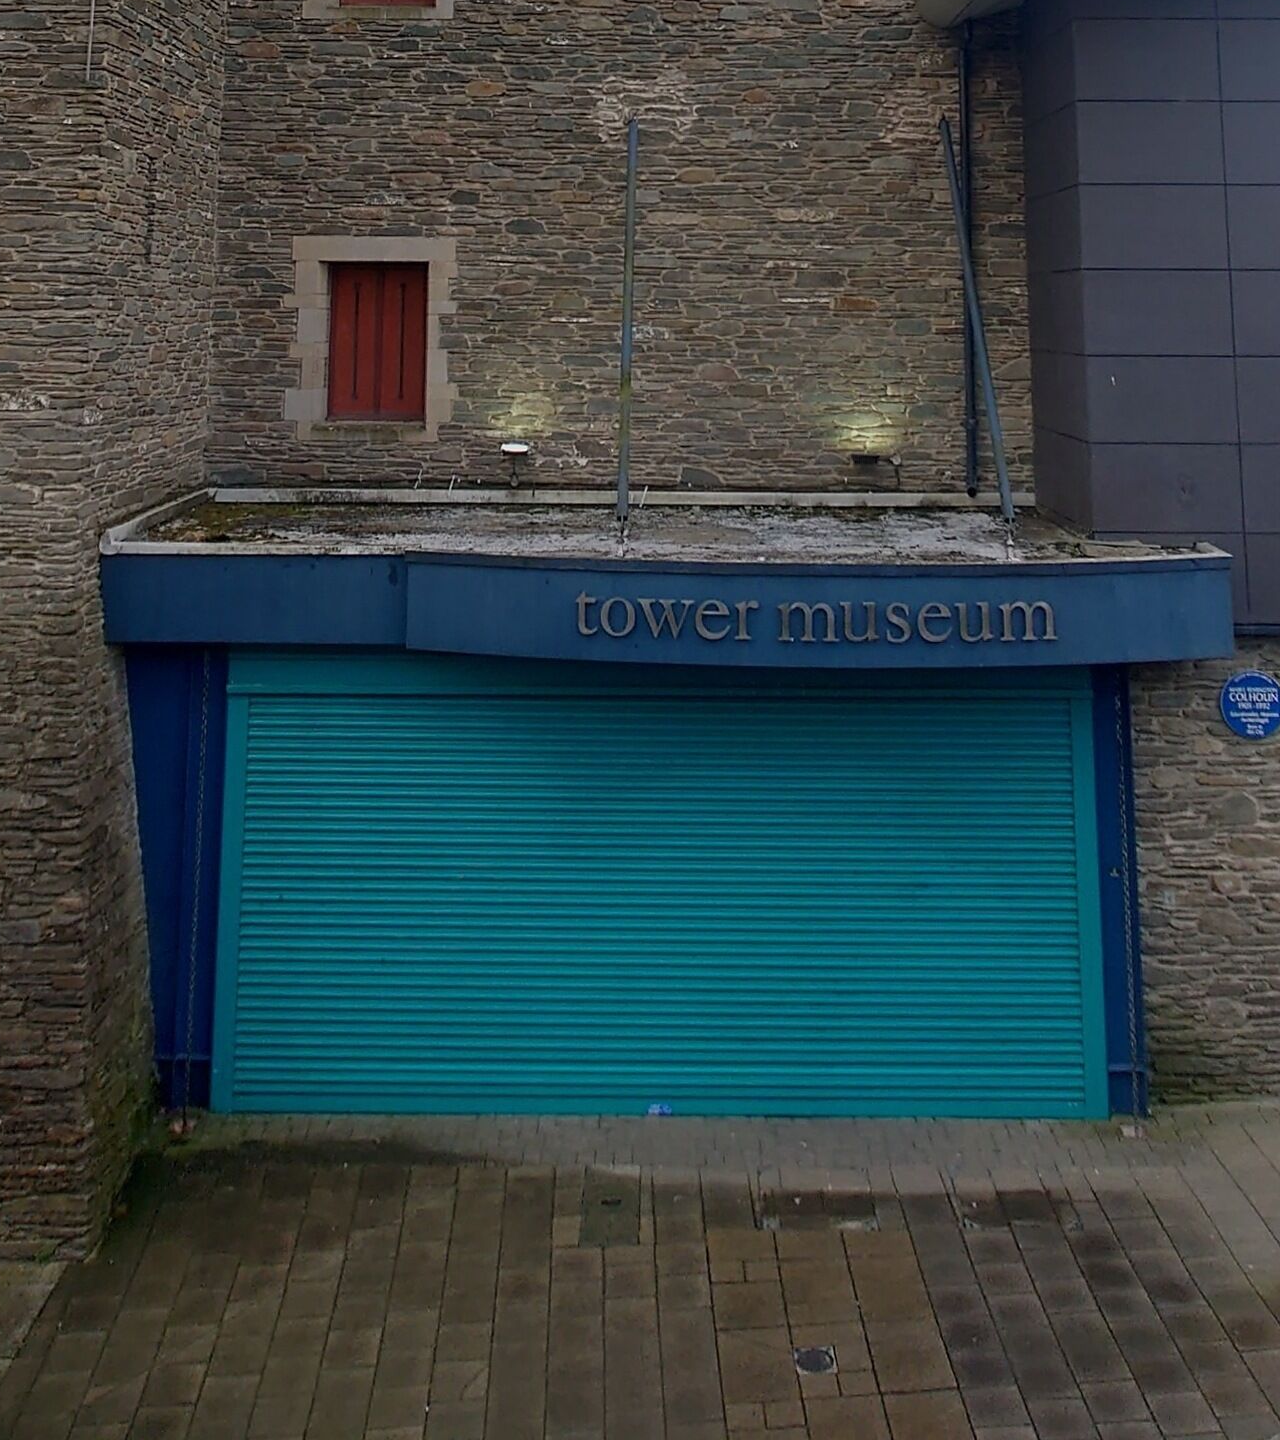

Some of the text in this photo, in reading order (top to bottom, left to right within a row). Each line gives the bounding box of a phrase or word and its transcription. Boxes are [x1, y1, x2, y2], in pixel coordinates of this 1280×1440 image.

[575, 590, 1058, 644] tower museum
[1228, 692, 1279, 703] COLHOUN
